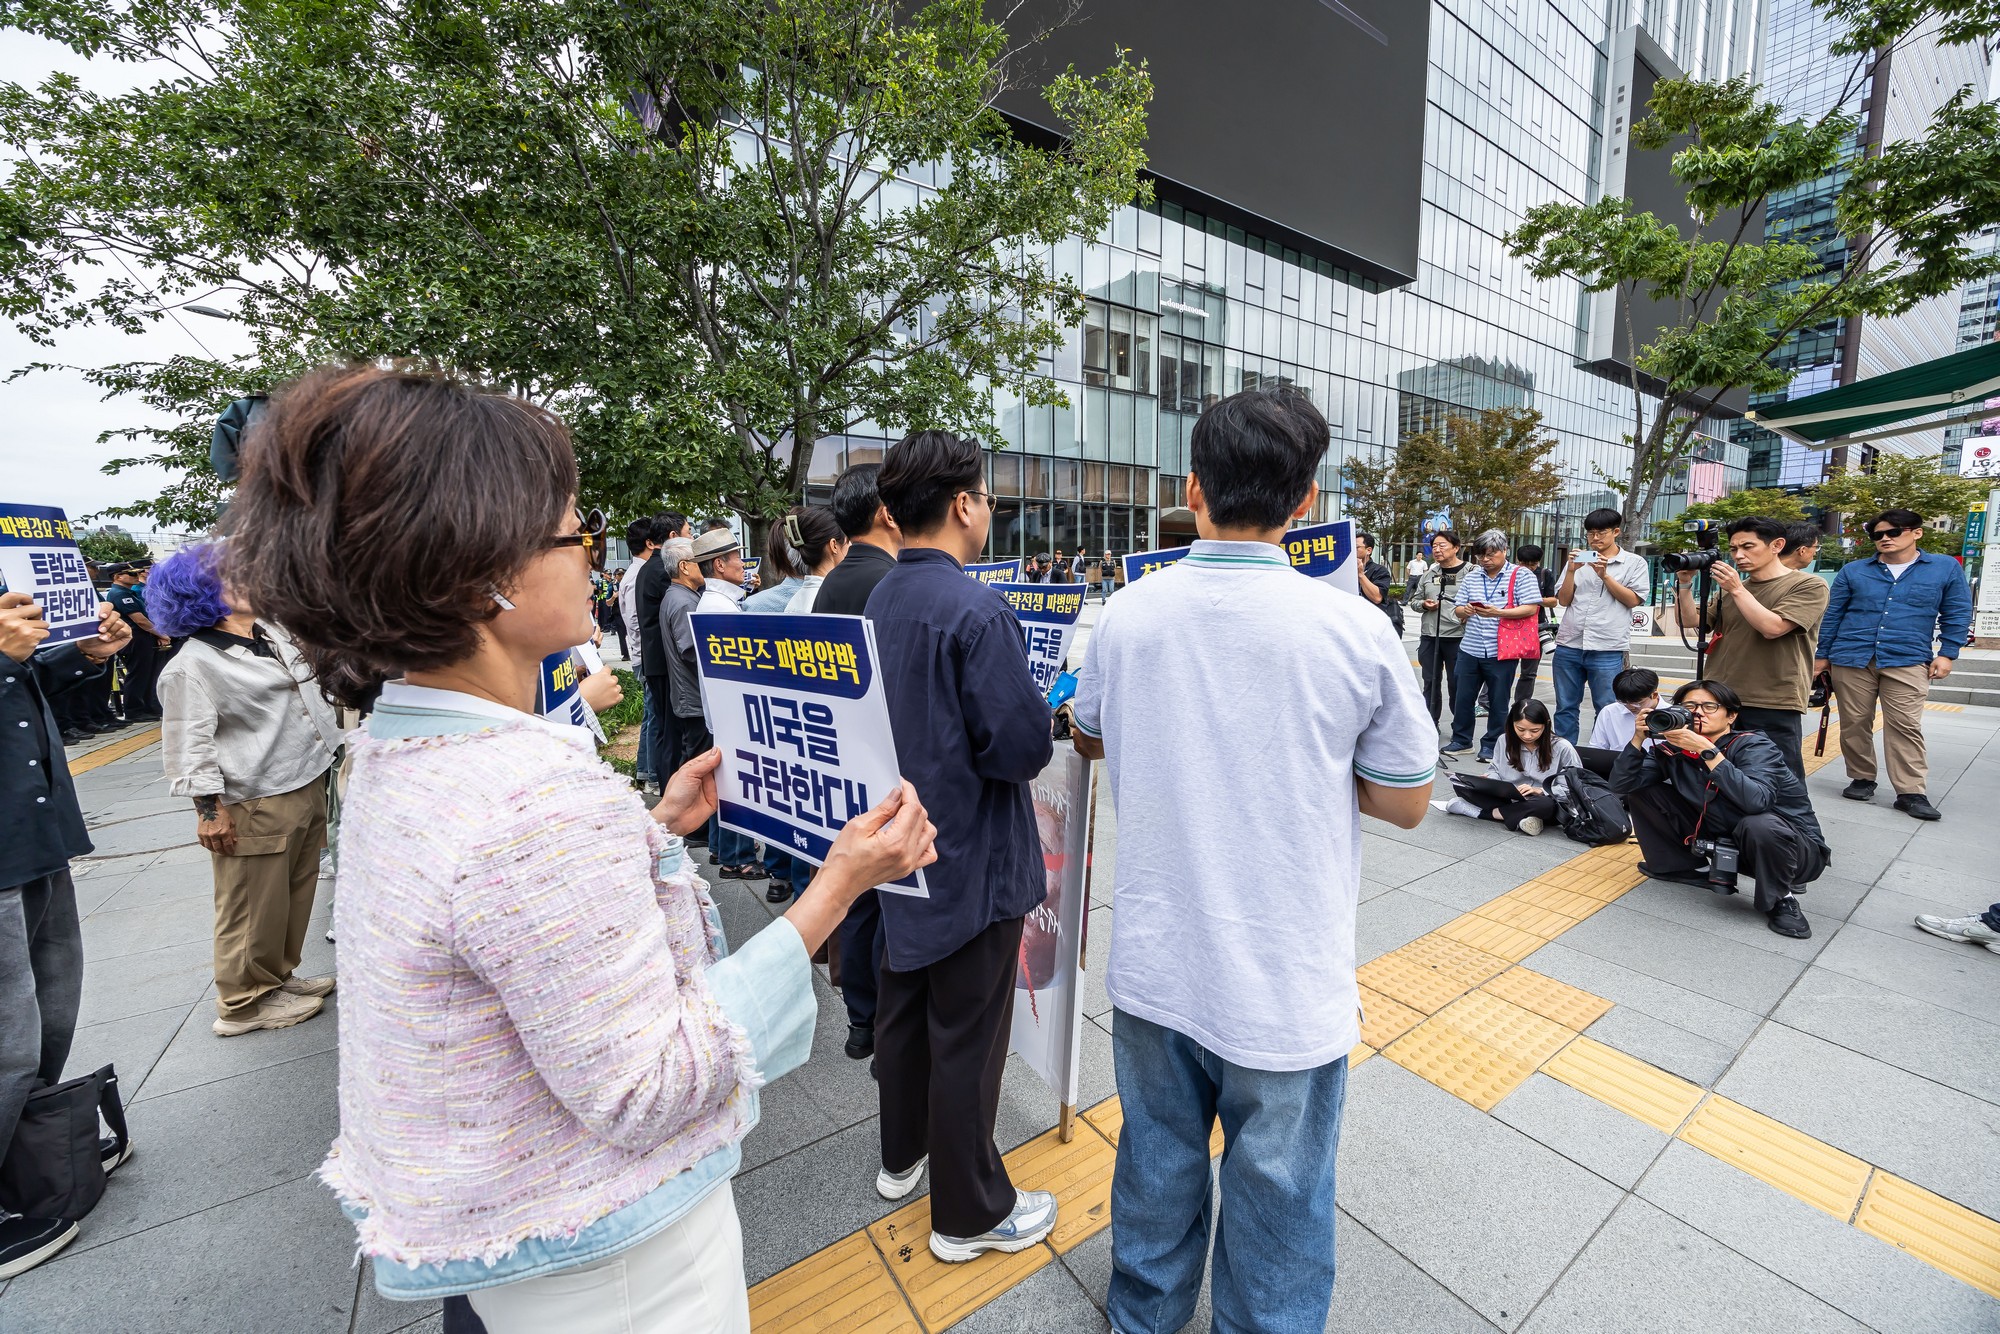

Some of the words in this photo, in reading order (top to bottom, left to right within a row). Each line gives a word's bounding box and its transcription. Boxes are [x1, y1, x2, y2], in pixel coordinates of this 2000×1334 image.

[1972, 459, 1991, 468] LG
[0, 515, 54, 538] 파병강요
[1279, 535, 1337, 567] 압박
[29, 552, 88, 586] 트럼프를
[1045, 593, 1082, 614] 파병압박
[706, 633, 775, 671] 호르무즈
[775, 638, 860, 685] 파병압박
[742, 693, 840, 767] 미국을
